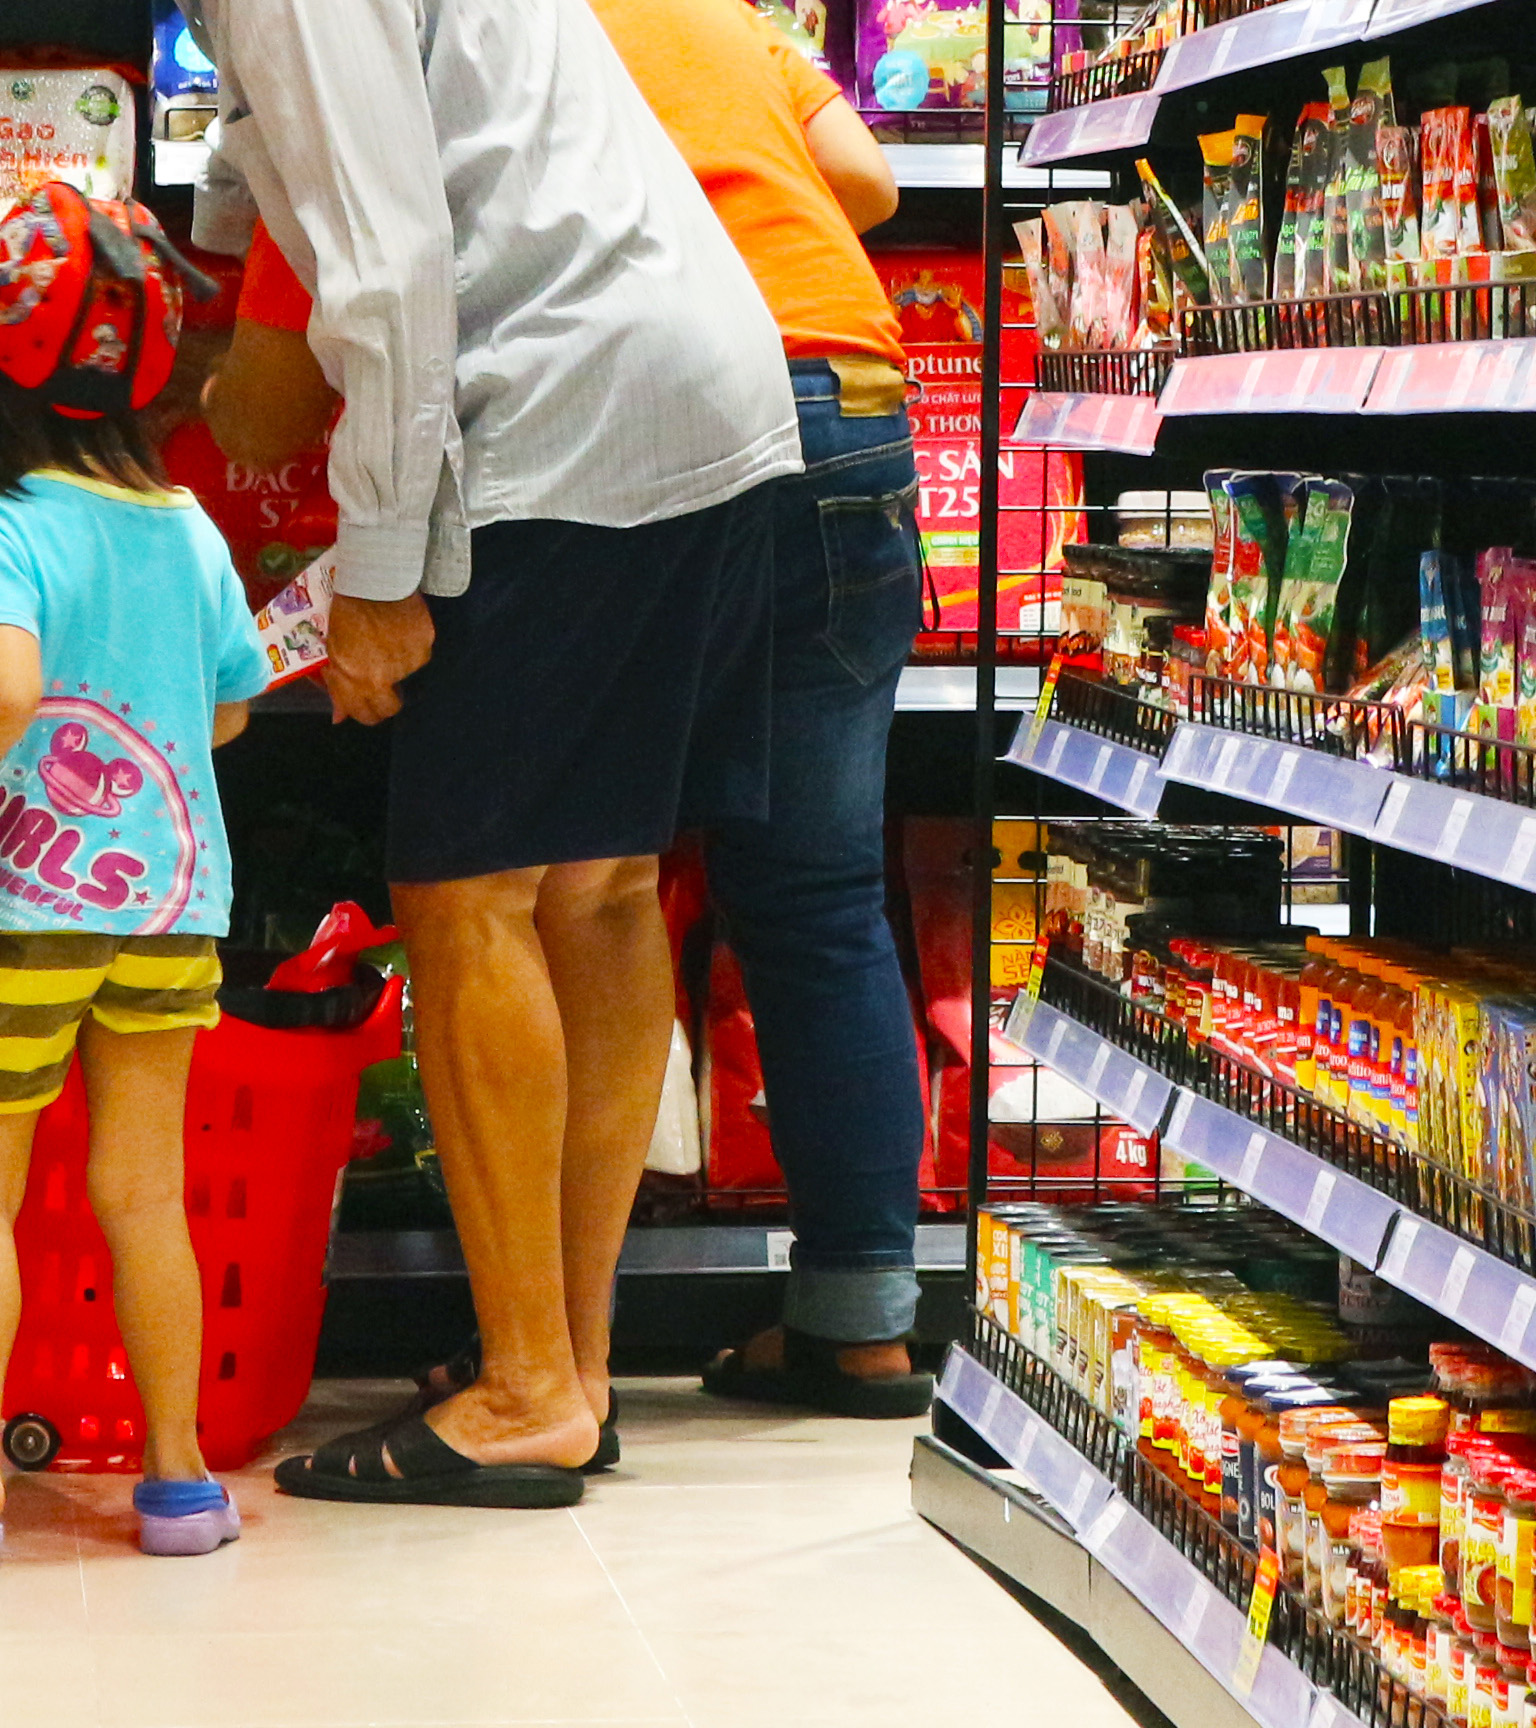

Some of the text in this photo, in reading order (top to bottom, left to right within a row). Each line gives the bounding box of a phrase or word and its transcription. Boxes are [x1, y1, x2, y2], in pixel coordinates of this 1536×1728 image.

[907, 353, 983, 379] ptune
[931, 392, 960, 404] CHẤT
[919, 486, 980, 518] T25
